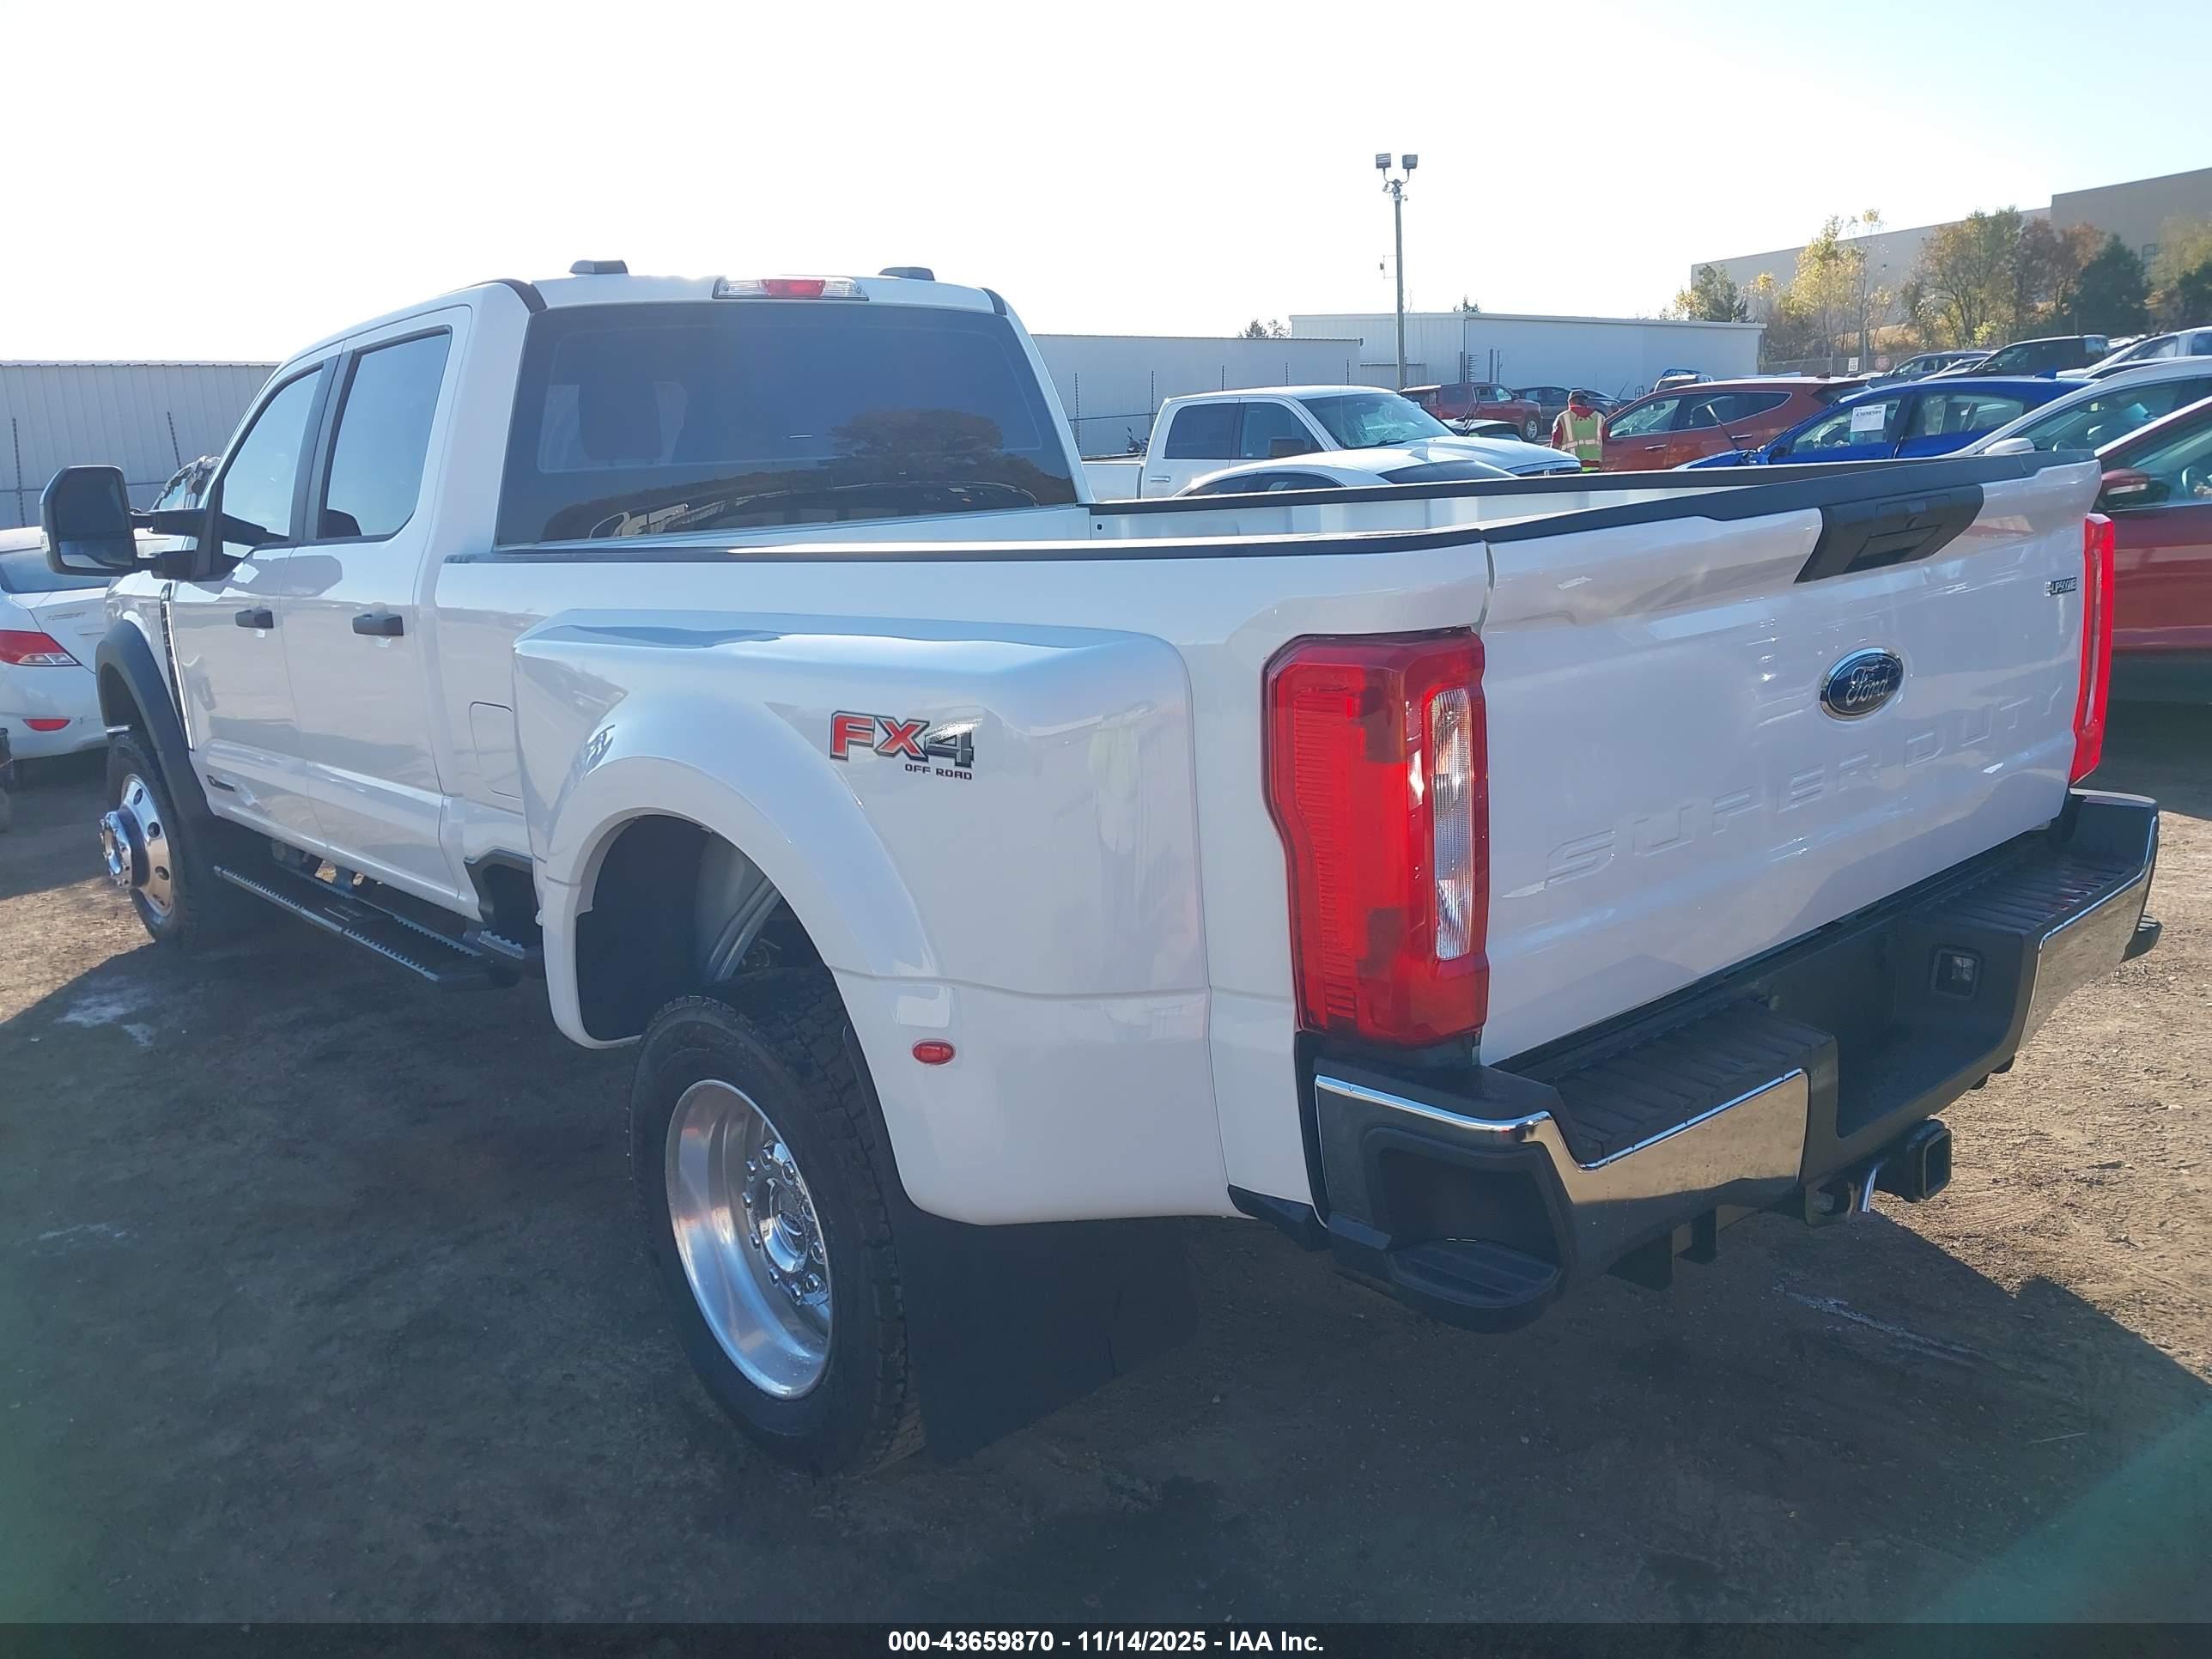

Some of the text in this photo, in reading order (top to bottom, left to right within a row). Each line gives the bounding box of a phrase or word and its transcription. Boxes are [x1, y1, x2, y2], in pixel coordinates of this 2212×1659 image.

[1845, 664, 1892, 706] Ford
[830, 710, 975, 769] FX4
[904, 763, 973, 781] OFF ROAD
[1545, 684, 2063, 888] SUPER DUTY
